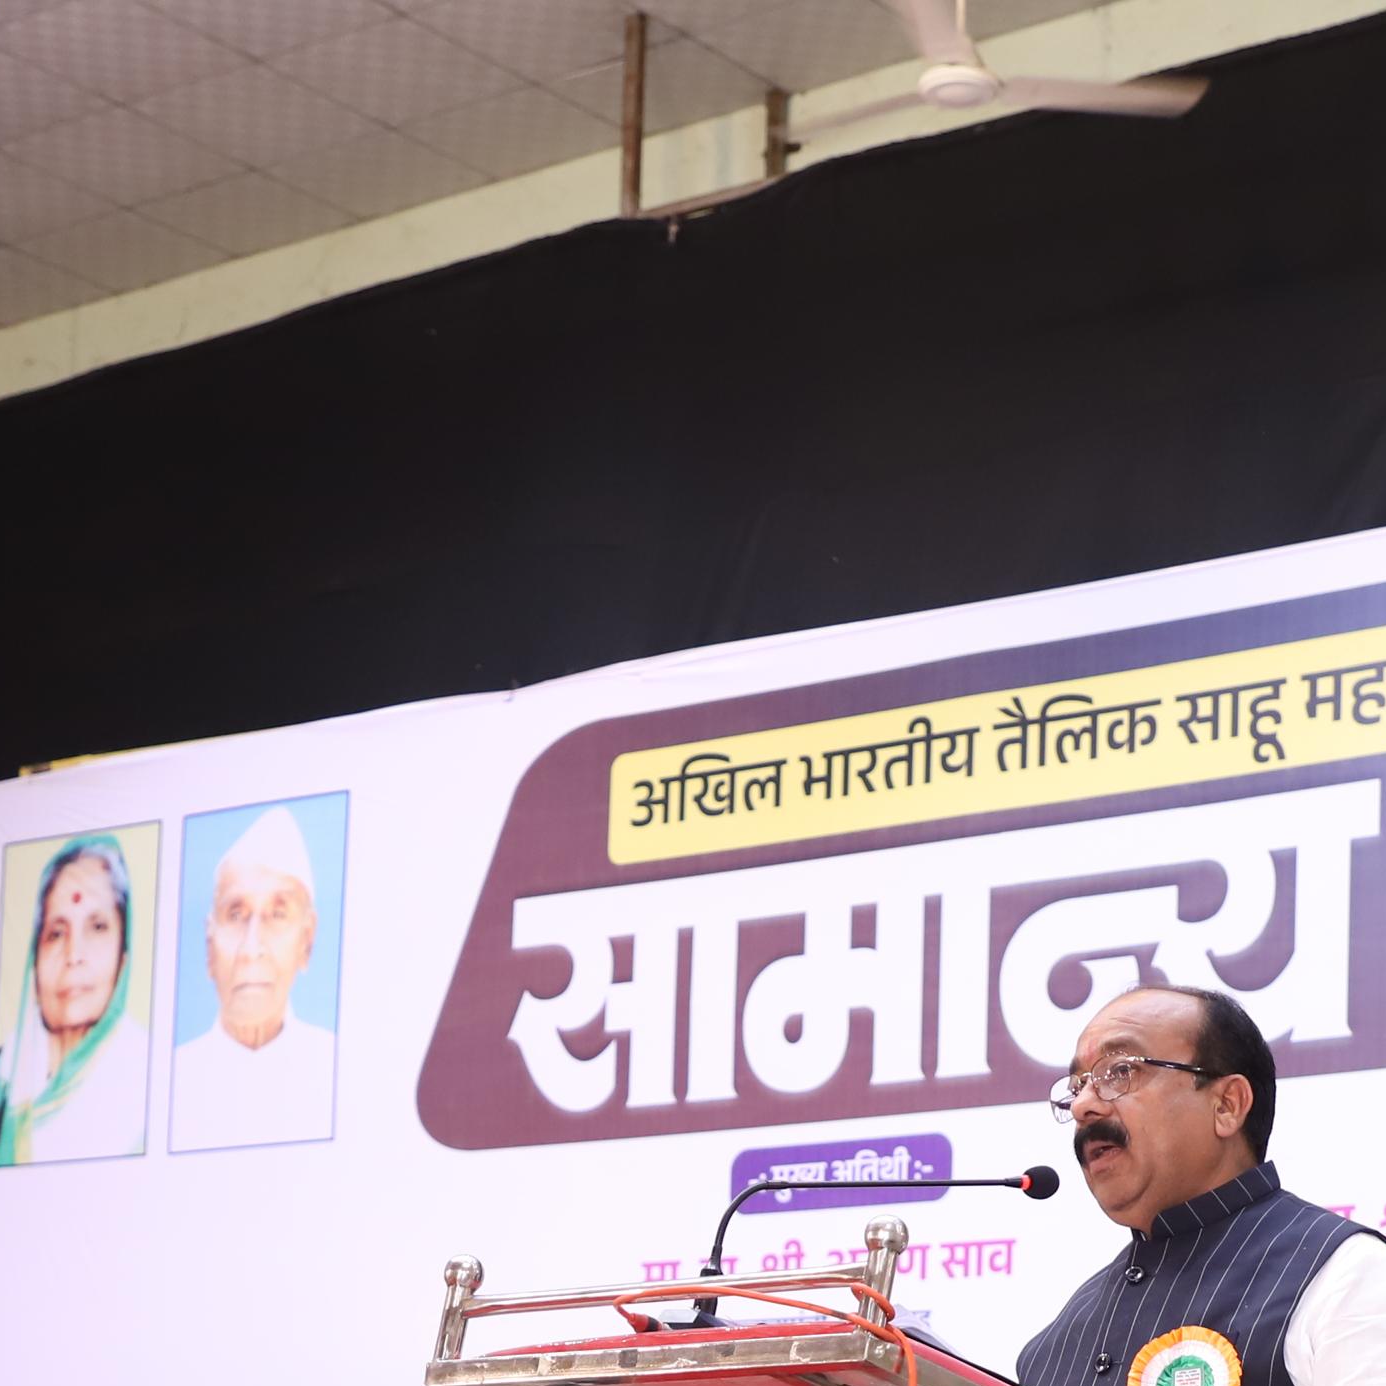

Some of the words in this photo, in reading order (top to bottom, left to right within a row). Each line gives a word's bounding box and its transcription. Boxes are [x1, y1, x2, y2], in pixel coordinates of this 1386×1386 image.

[630, 754, 786, 828] अखिल
[800, 717, 979, 802] भारतीय
[993, 694, 1161, 775] तैलिक
[1176, 674, 1287, 764] साहू
[508, 778, 1381, 1113] सामान्य
[941, 1238, 1016, 1280] साव
